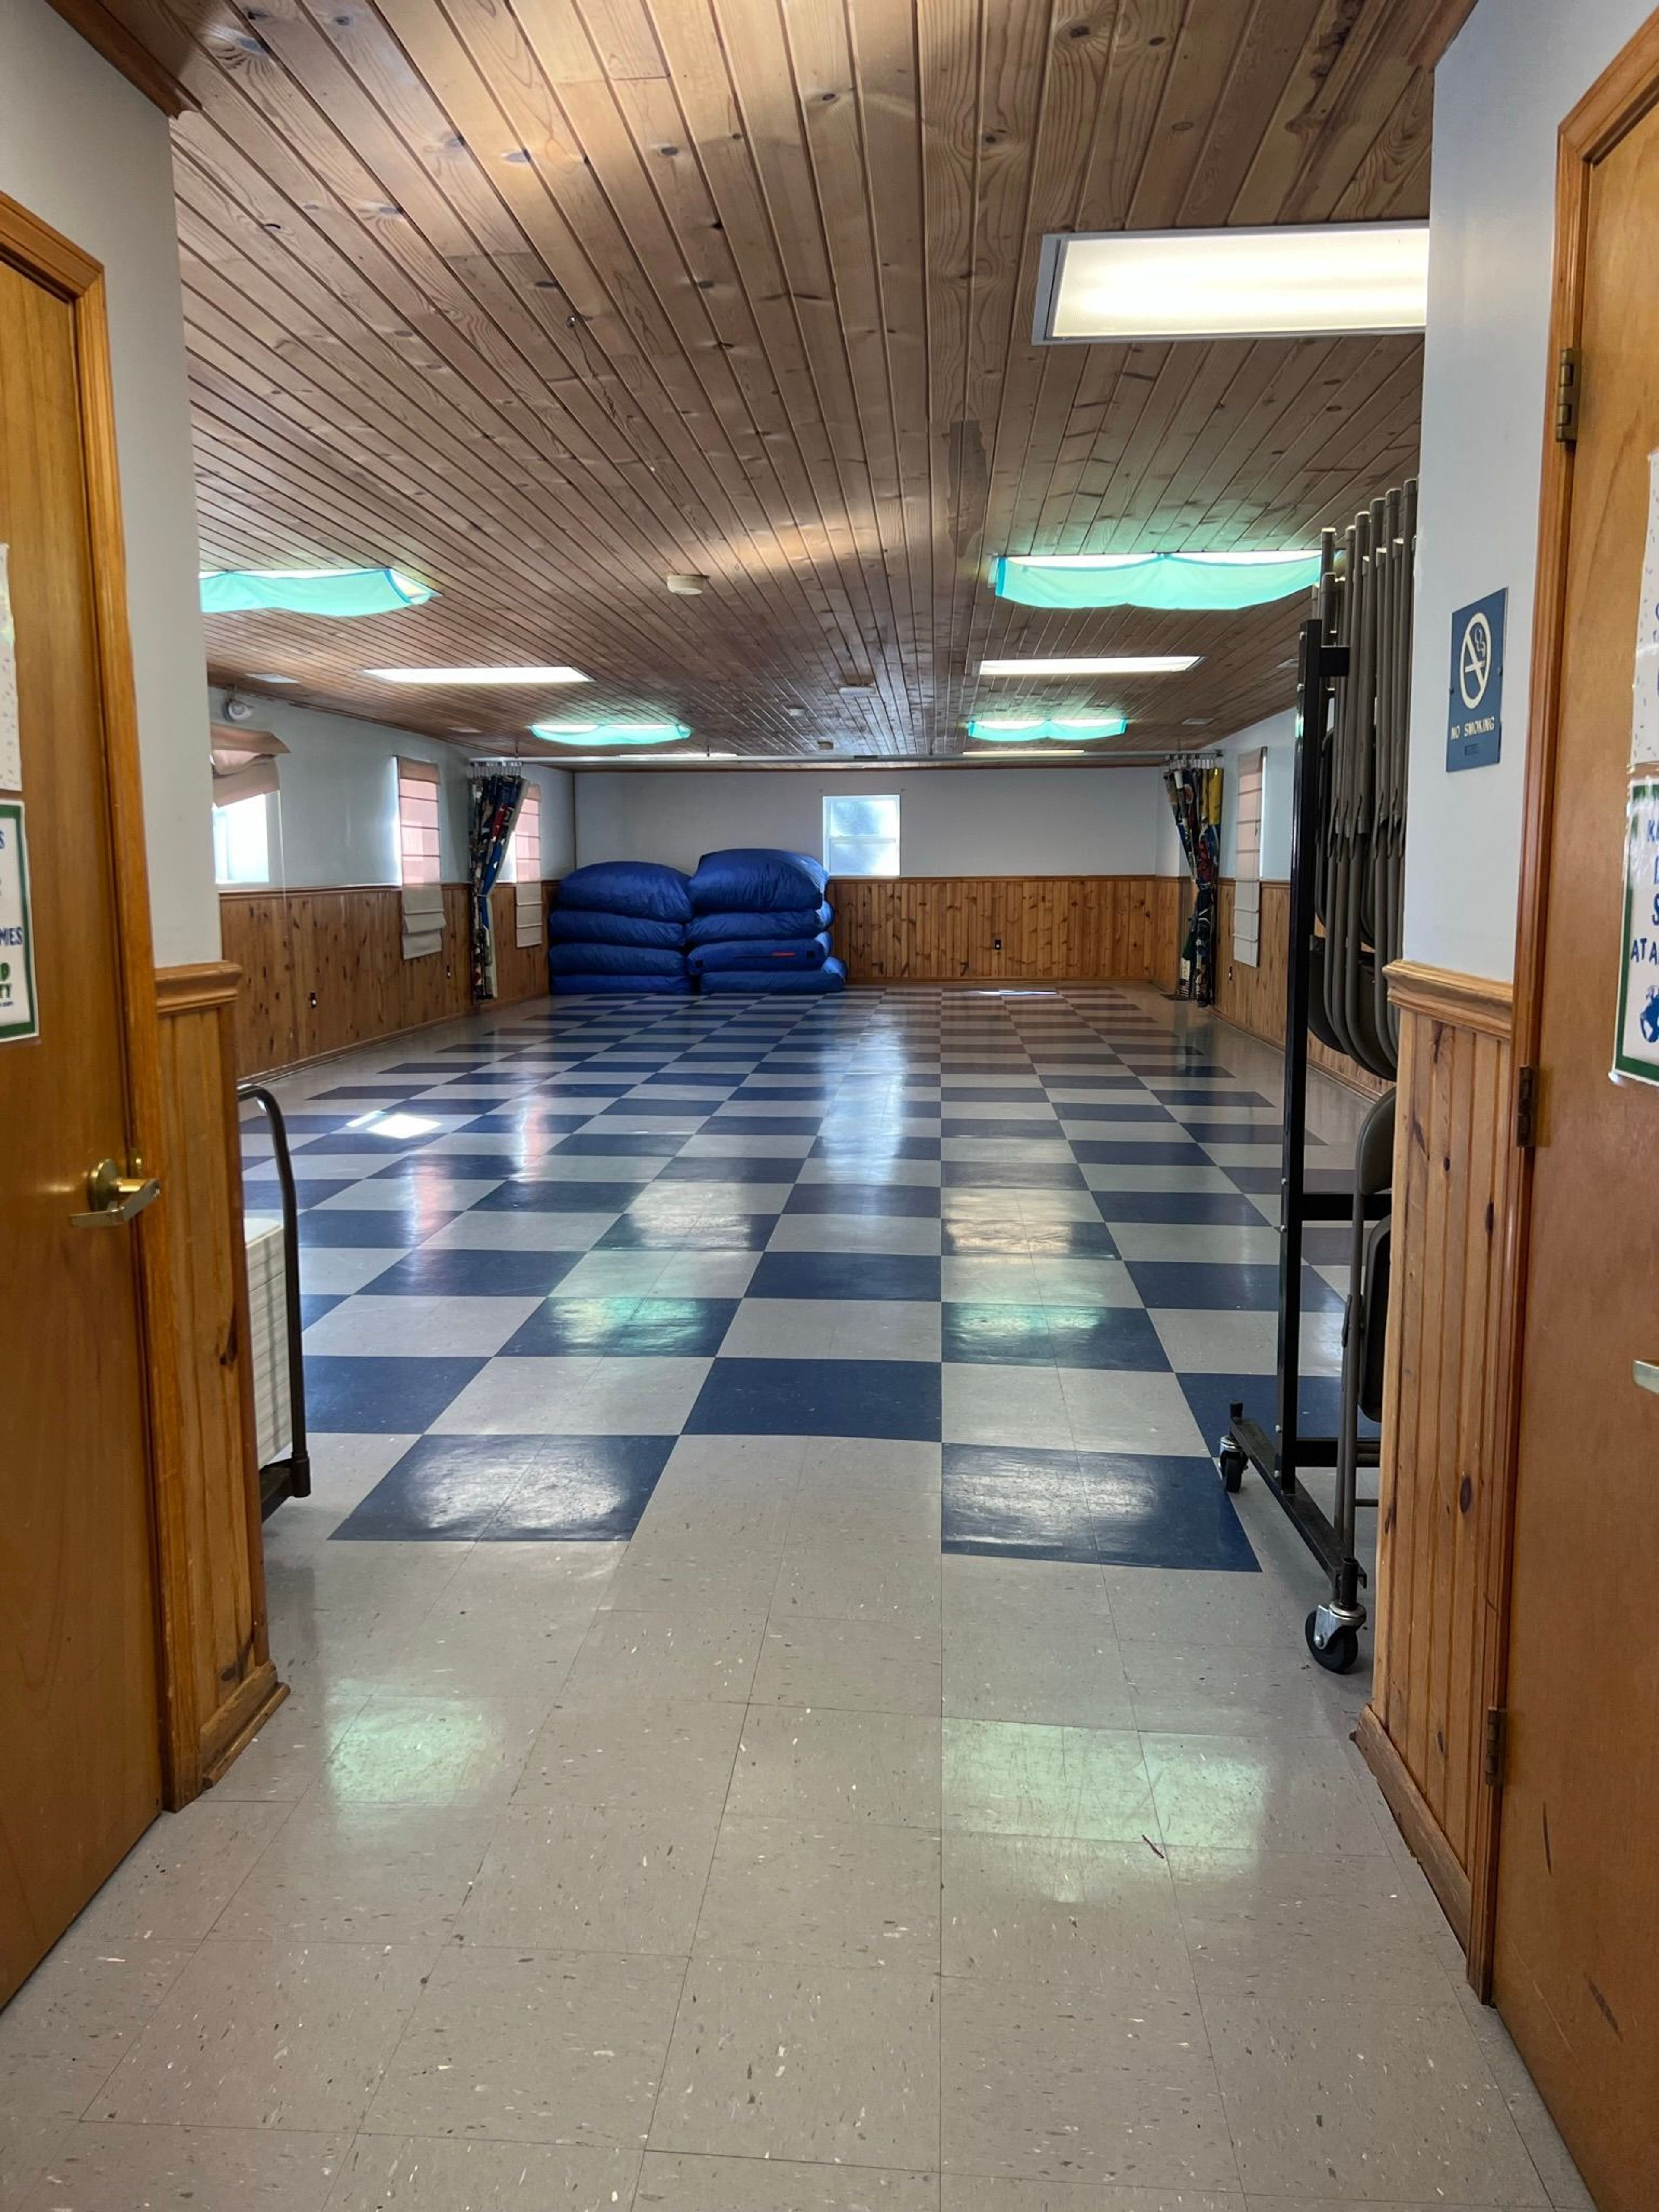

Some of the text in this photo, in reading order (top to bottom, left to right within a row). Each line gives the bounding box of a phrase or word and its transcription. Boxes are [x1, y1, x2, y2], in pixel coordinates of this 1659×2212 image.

[1451, 716, 1495, 740] NO SMOKING
[1631, 938, 1647, 963] AT
